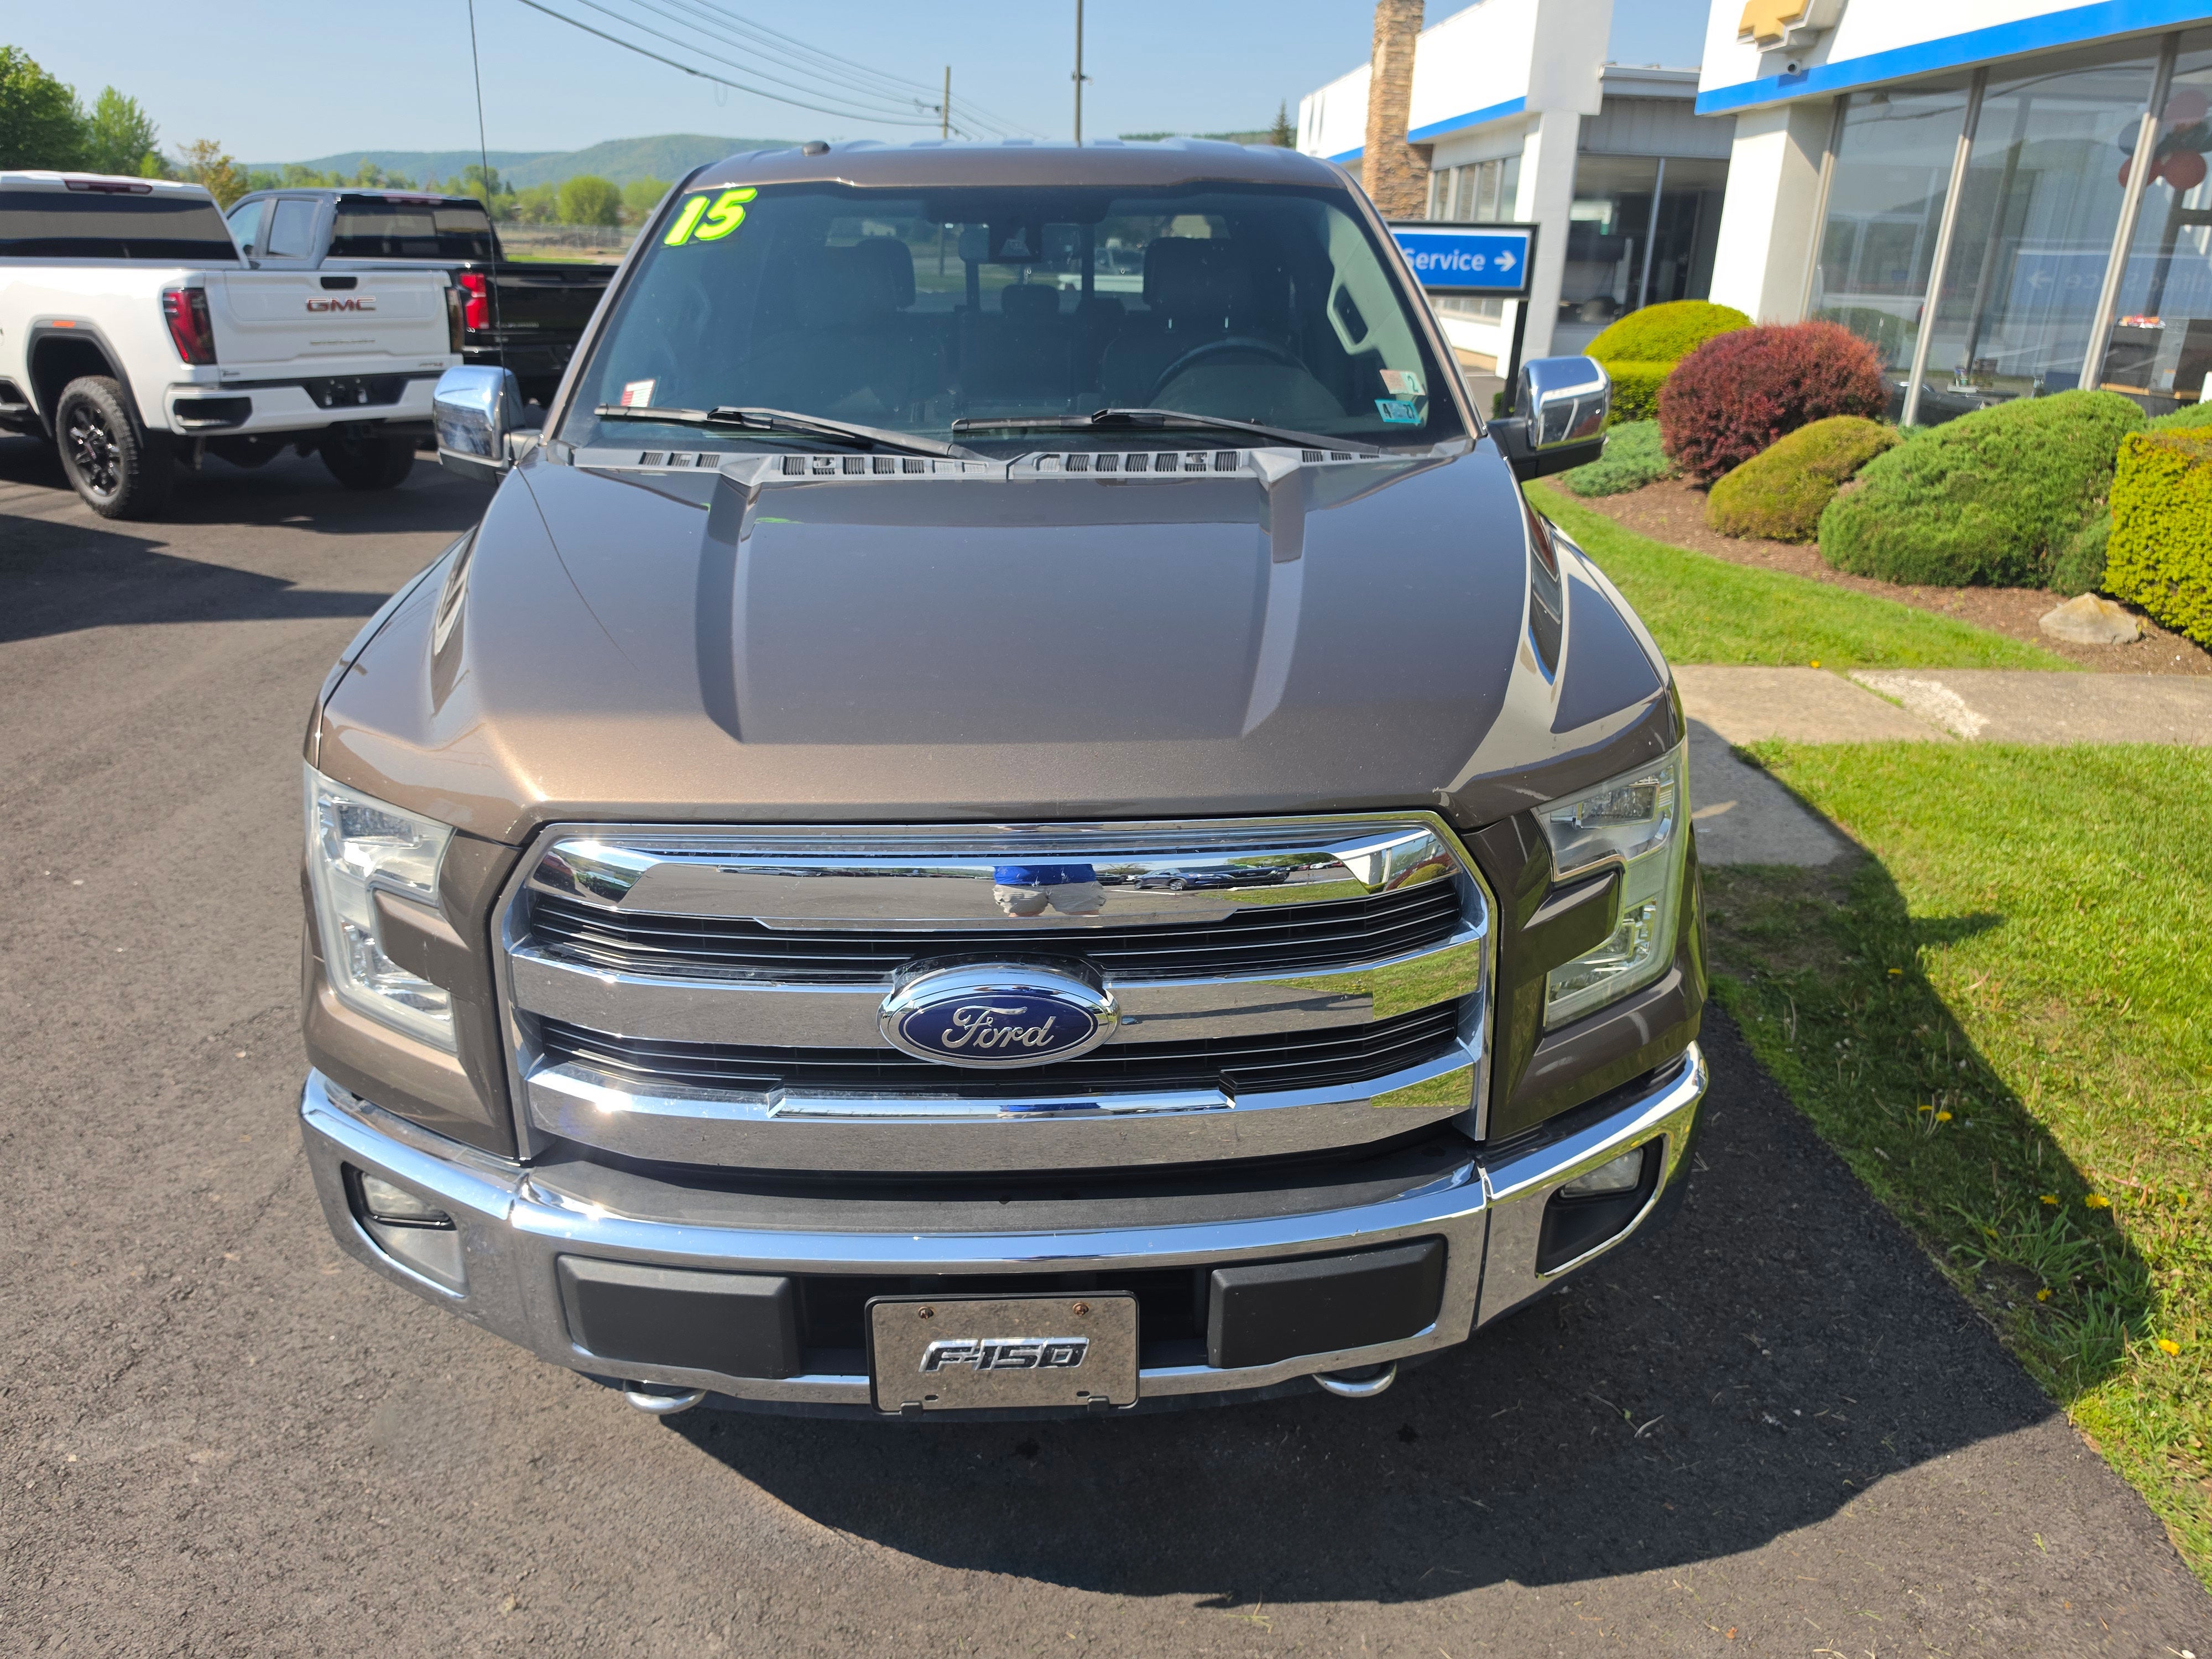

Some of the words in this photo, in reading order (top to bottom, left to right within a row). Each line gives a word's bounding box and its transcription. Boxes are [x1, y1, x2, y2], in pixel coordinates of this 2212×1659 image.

[664, 187, 758, 246] 15
[1402, 247, 1486, 272] Service
[306, 296, 376, 311] GMC
[942, 1005, 1056, 1048] Ford
[917, 1337, 1090, 1373] F-150
